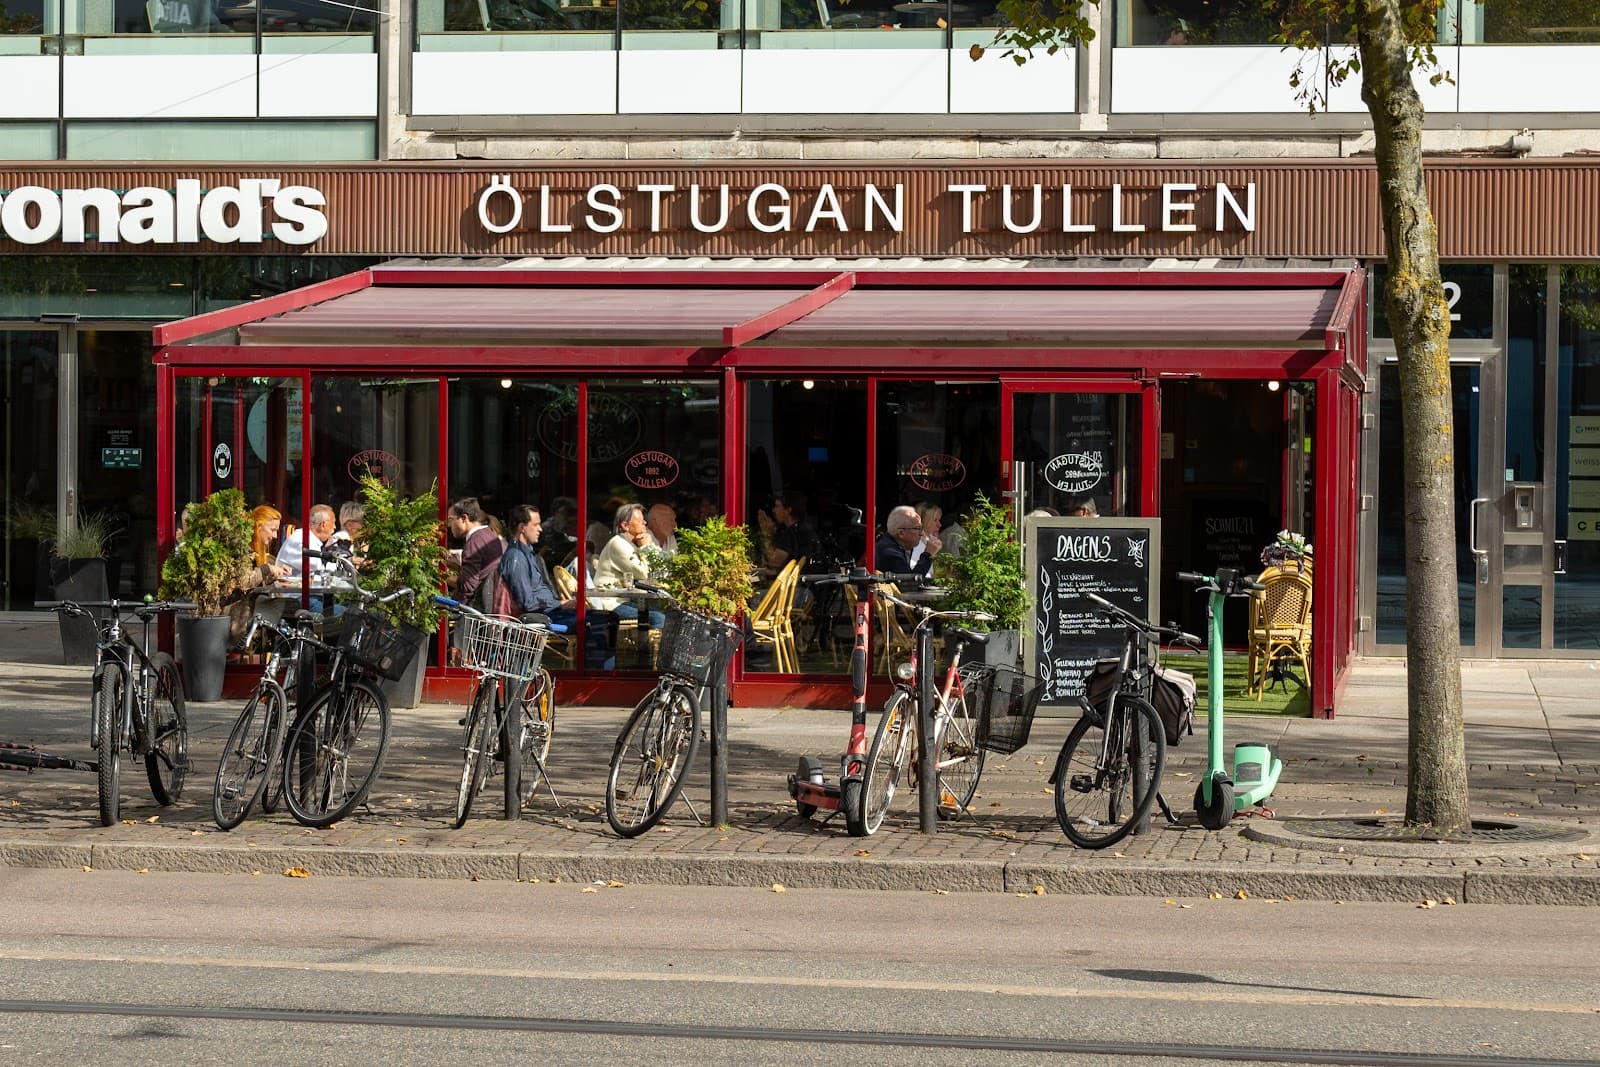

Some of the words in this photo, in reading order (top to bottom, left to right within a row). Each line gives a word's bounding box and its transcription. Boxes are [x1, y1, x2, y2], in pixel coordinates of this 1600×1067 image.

[0, 178, 328, 245] onald's
[478, 174, 904, 233] ÖLSTUGAN
[948, 182, 1256, 233] TULLEN
[1057, 535, 1111, 558] DAGENS
